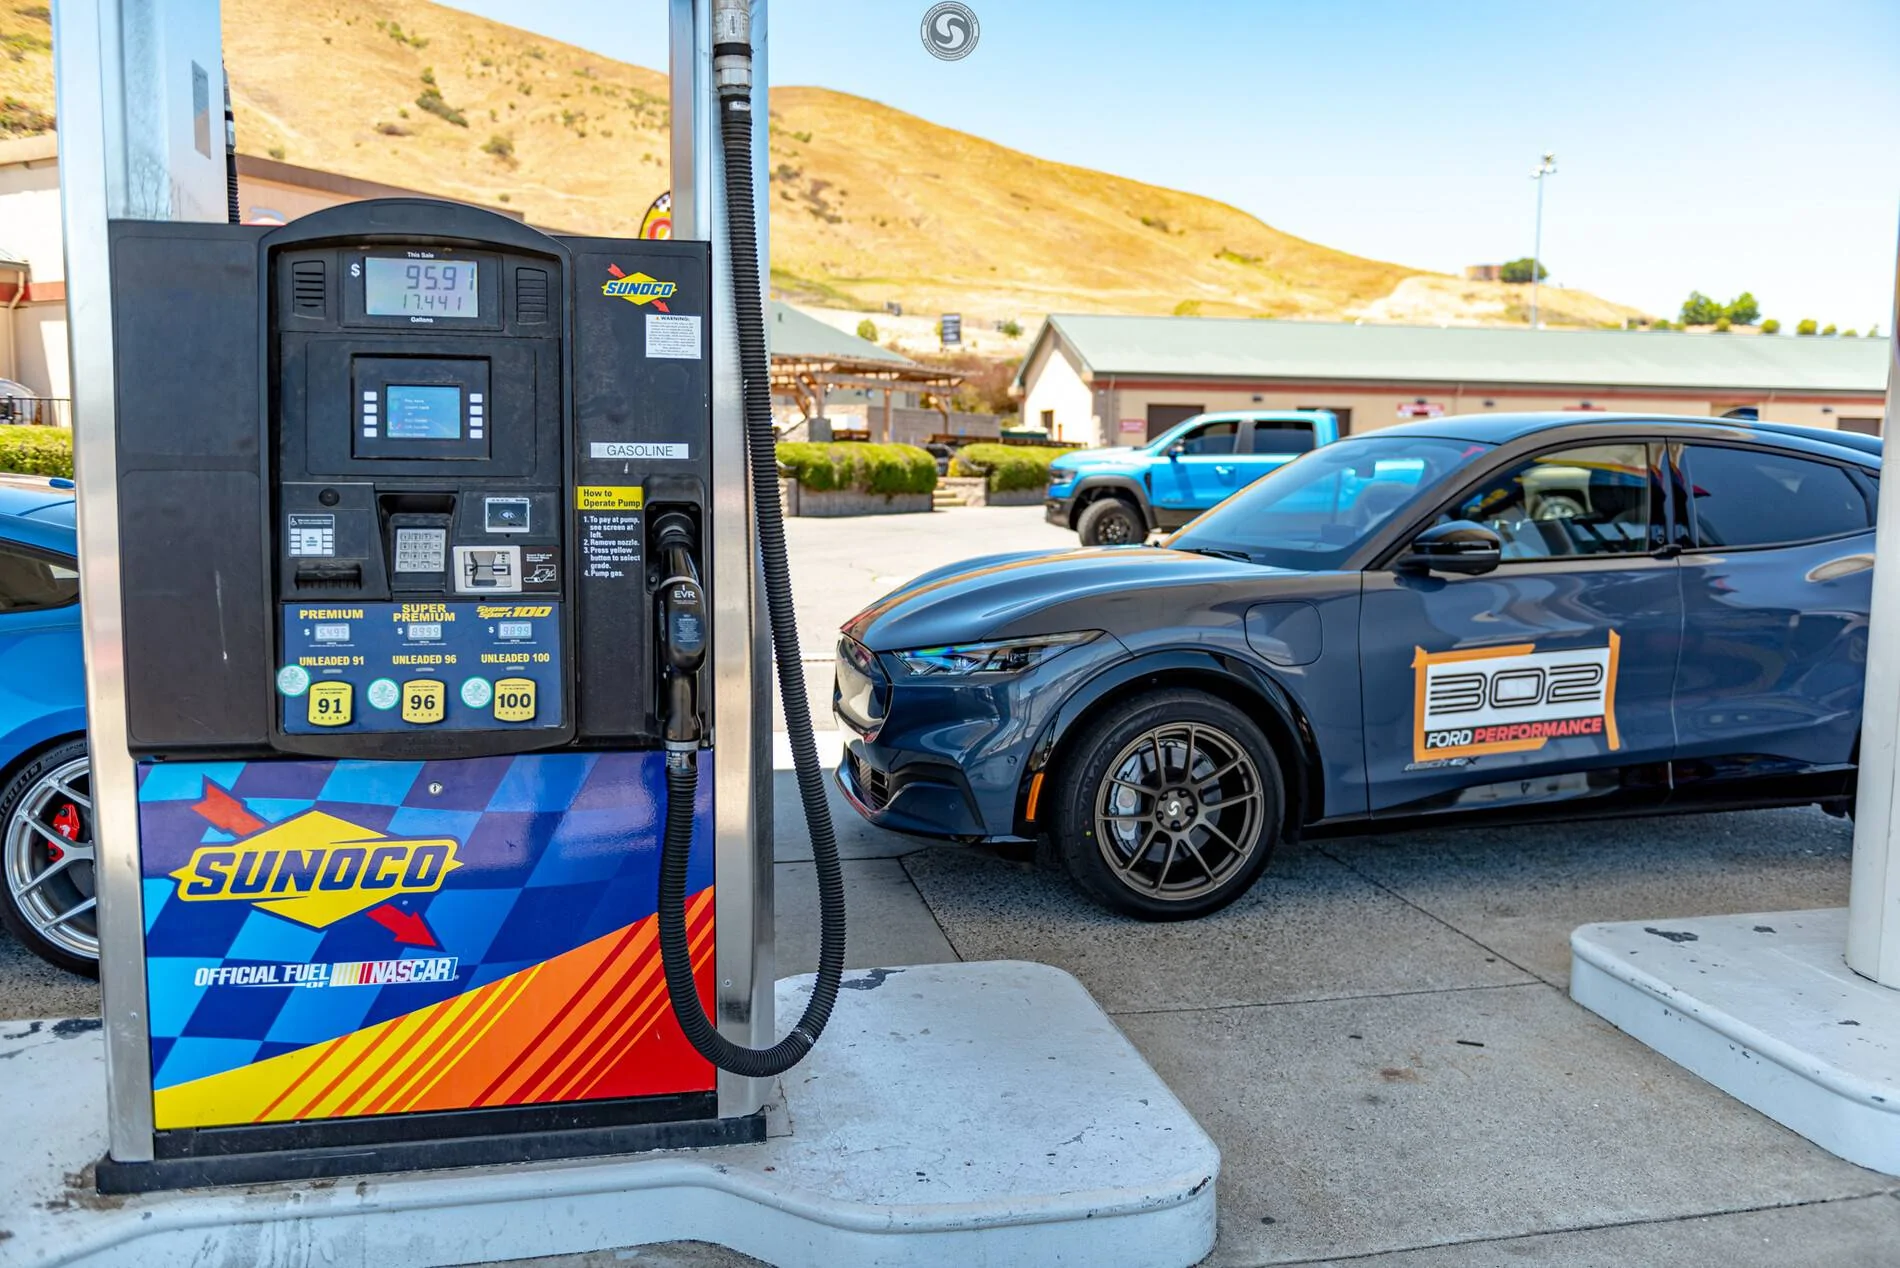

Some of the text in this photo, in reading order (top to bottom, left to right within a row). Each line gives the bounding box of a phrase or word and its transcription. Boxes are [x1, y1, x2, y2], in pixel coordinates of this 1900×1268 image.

[351, 263, 360, 277] $
[606, 282, 674, 296] SUNOCO
[606, 445, 673, 457] GASOLINE
[583, 489, 612, 497] How to
[583, 499, 640, 509] Operate Pump
[599, 517, 611, 525] pay
[610, 547, 633, 555] yellow
[590, 570, 609, 578] Pump
[674, 590, 696, 599] EVR
[402, 604, 446, 613] SUPER
[512, 606, 553, 617] 100
[299, 609, 364, 619] PREMIUM
[393, 612, 455, 622] PREMIUM
[299, 656, 364, 665] UNLEADED 91
[392, 655, 457, 664] UNLEADED 96
[481, 653, 550, 663] UNLEADED 100
[1429, 663, 1604, 715] 302
[410, 694, 435, 710] 96
[498, 693, 531, 708] 100
[318, 698, 342, 714] 91
[1427, 717, 1603, 748] FORD PERFORMANCE
[0, 765, 39, 819] ICHELIN
[186, 844, 449, 895] SUNOCO
[194, 966, 279, 986] OFFICIAL
[281, 963, 330, 982] FUEL
[369, 959, 452, 984] NASCAR
